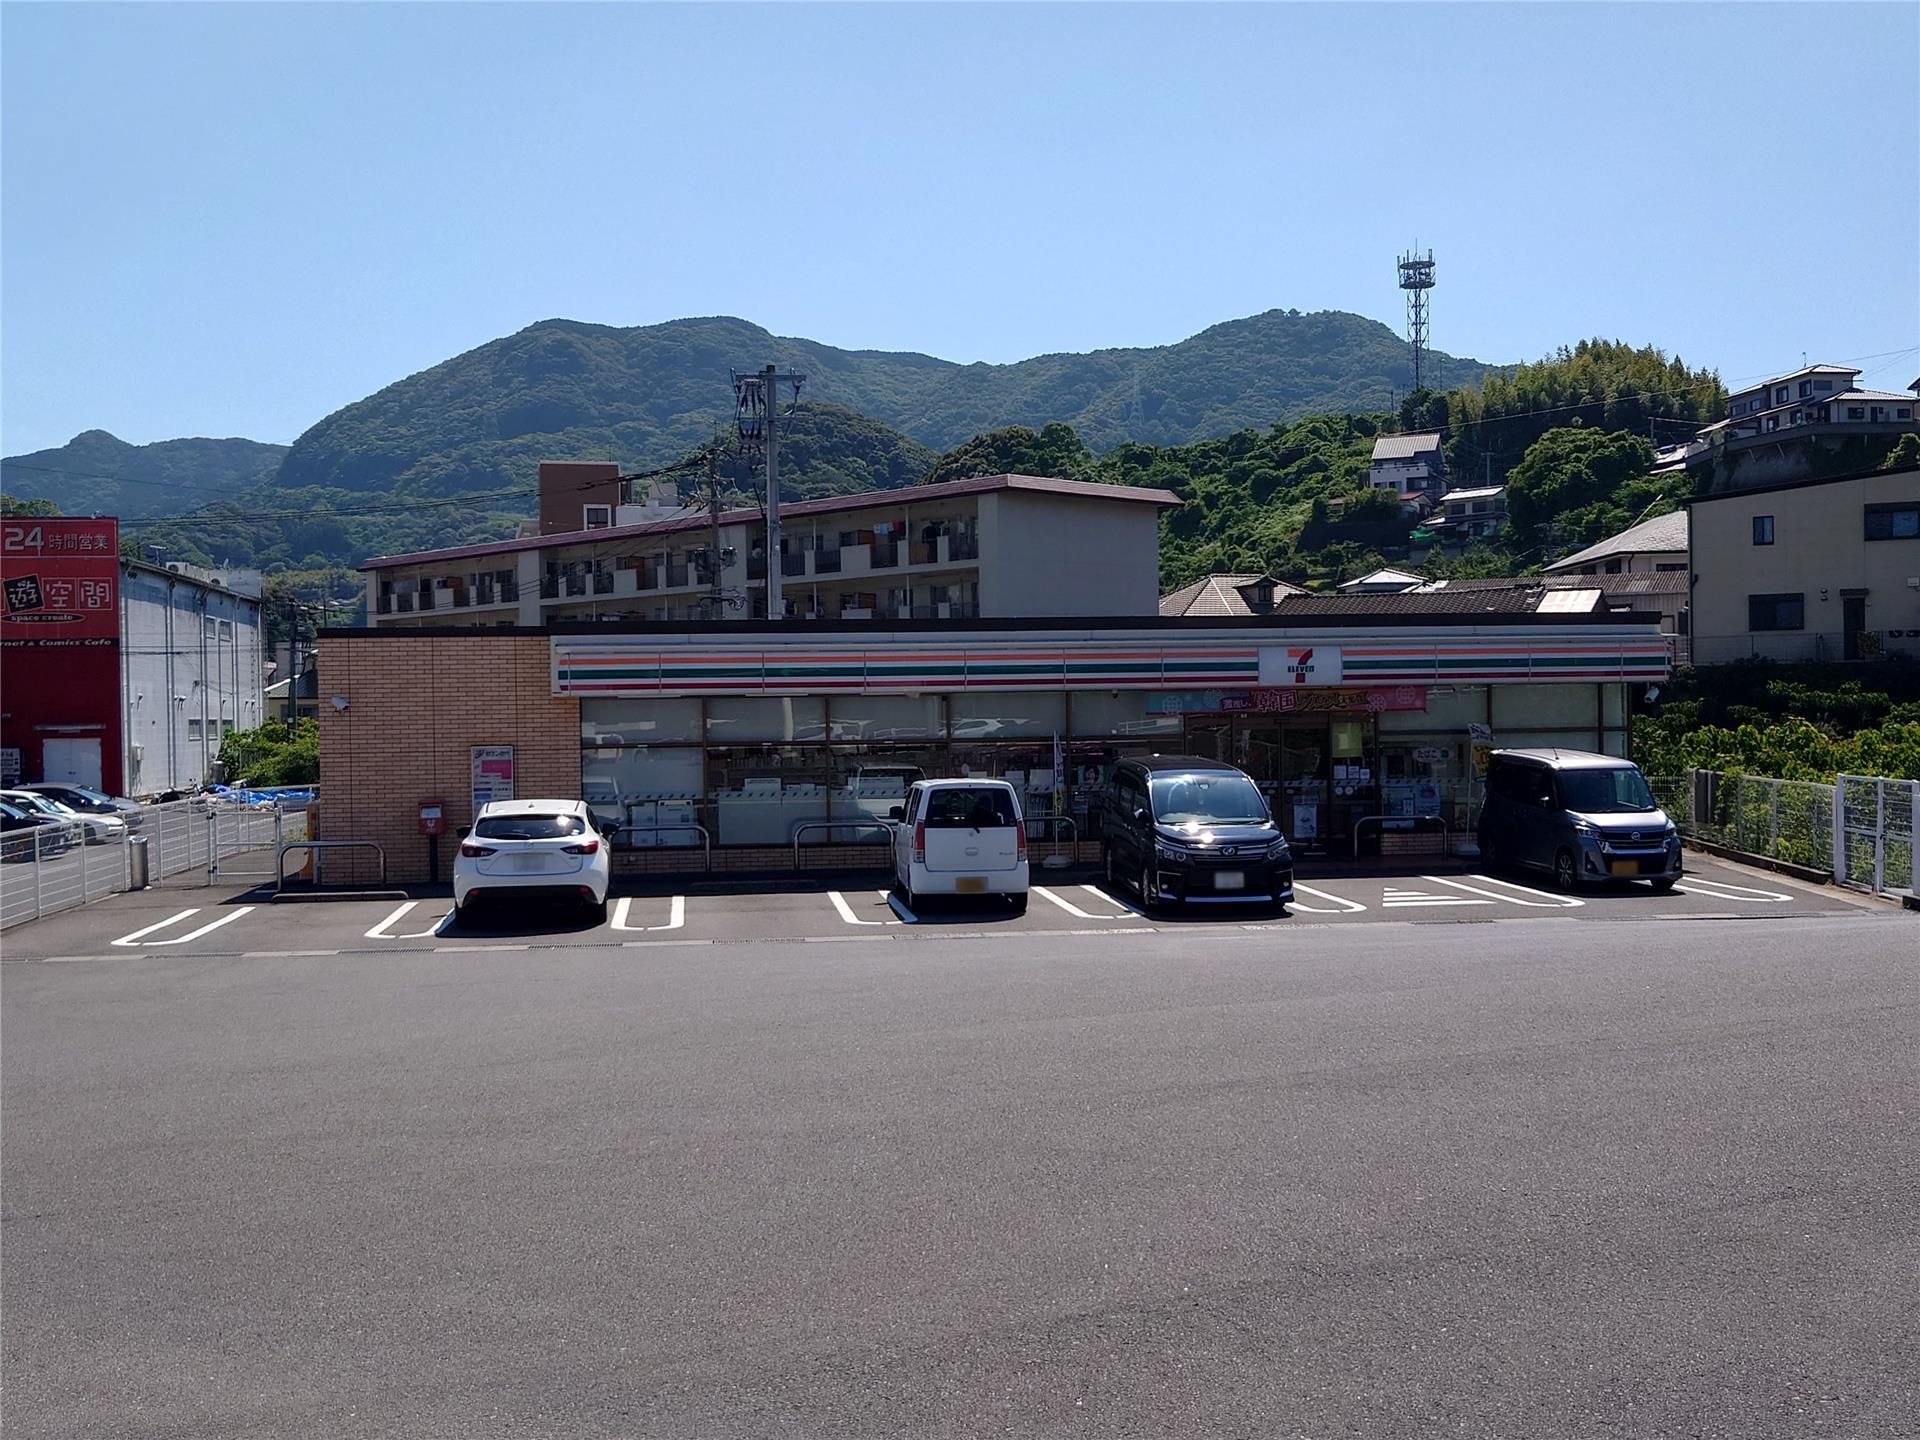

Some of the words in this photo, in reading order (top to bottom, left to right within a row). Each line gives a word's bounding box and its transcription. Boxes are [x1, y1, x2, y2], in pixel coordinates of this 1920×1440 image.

[4, 526, 45, 551] 24
[48, 533, 109, 550] 時間営業
[11, 615, 40, 623] space
[39, 639, 81, 647] Comics
[84, 638, 112, 646] Cafe
